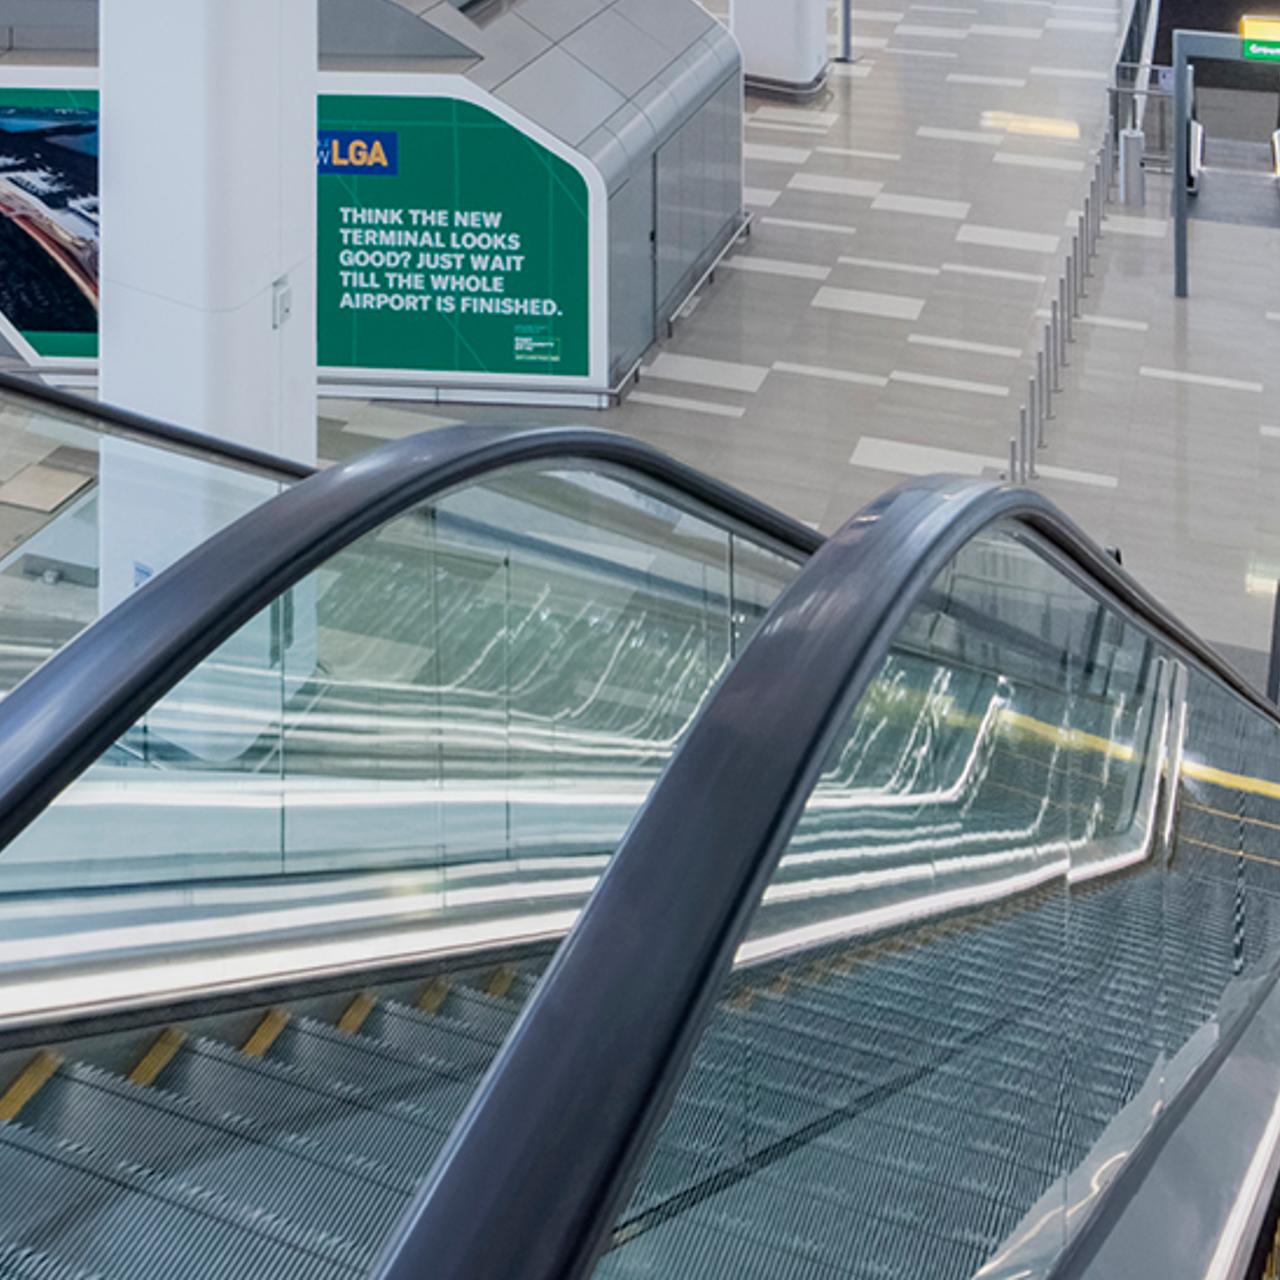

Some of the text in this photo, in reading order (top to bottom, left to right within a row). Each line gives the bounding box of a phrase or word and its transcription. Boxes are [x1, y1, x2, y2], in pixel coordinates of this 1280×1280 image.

[331, 139, 388, 167] LGA
[341, 207, 501, 227] THINK THE NEW
[340, 228, 520, 249] TERMINAL LOOKS
[340, 249, 524, 271] GOOD? JUST WAIT
[340, 271, 503, 292] TILL THE WHOLE
[340, 292, 561, 315] AIRPORT IS FINISHED.
